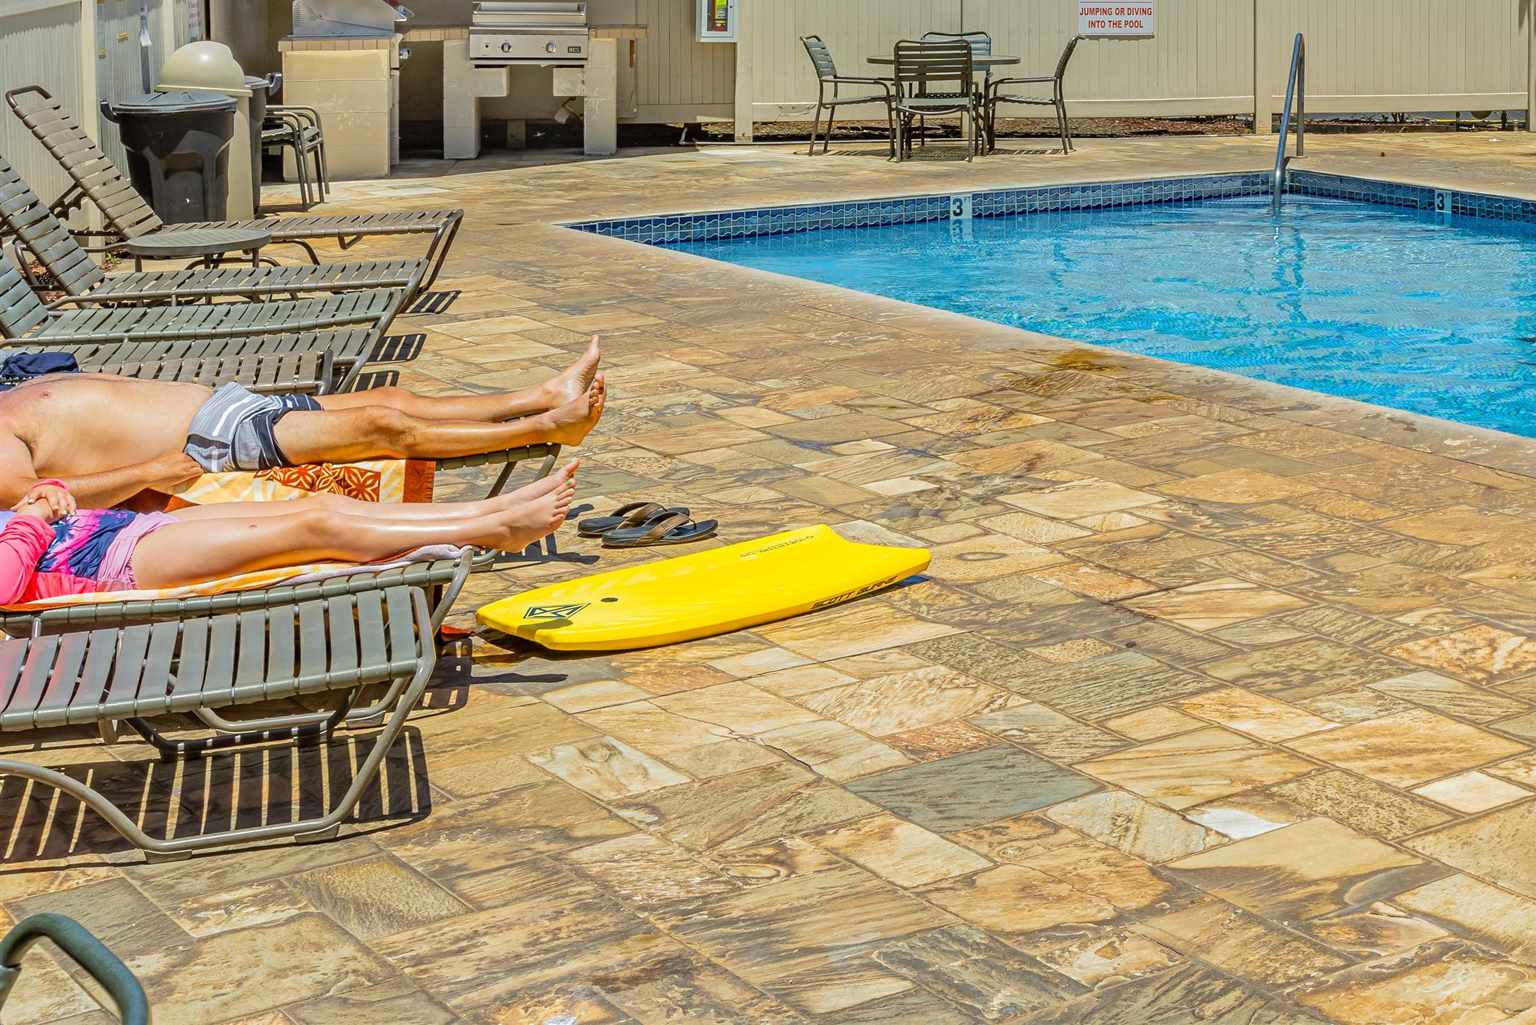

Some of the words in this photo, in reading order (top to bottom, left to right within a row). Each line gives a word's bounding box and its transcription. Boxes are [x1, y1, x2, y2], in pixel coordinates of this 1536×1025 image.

[1079, 7, 1113, 16] JUMPING
[1114, 7, 1126, 16] OR
[1127, 7, 1153, 16] DIVING
[1088, 19, 1106, 29] INTO
[1107, 19, 1122, 29] THE
[1123, 19, 1144, 29] POOL
[952, 197, 964, 217] 3
[1436, 192, 1445, 211] 3
